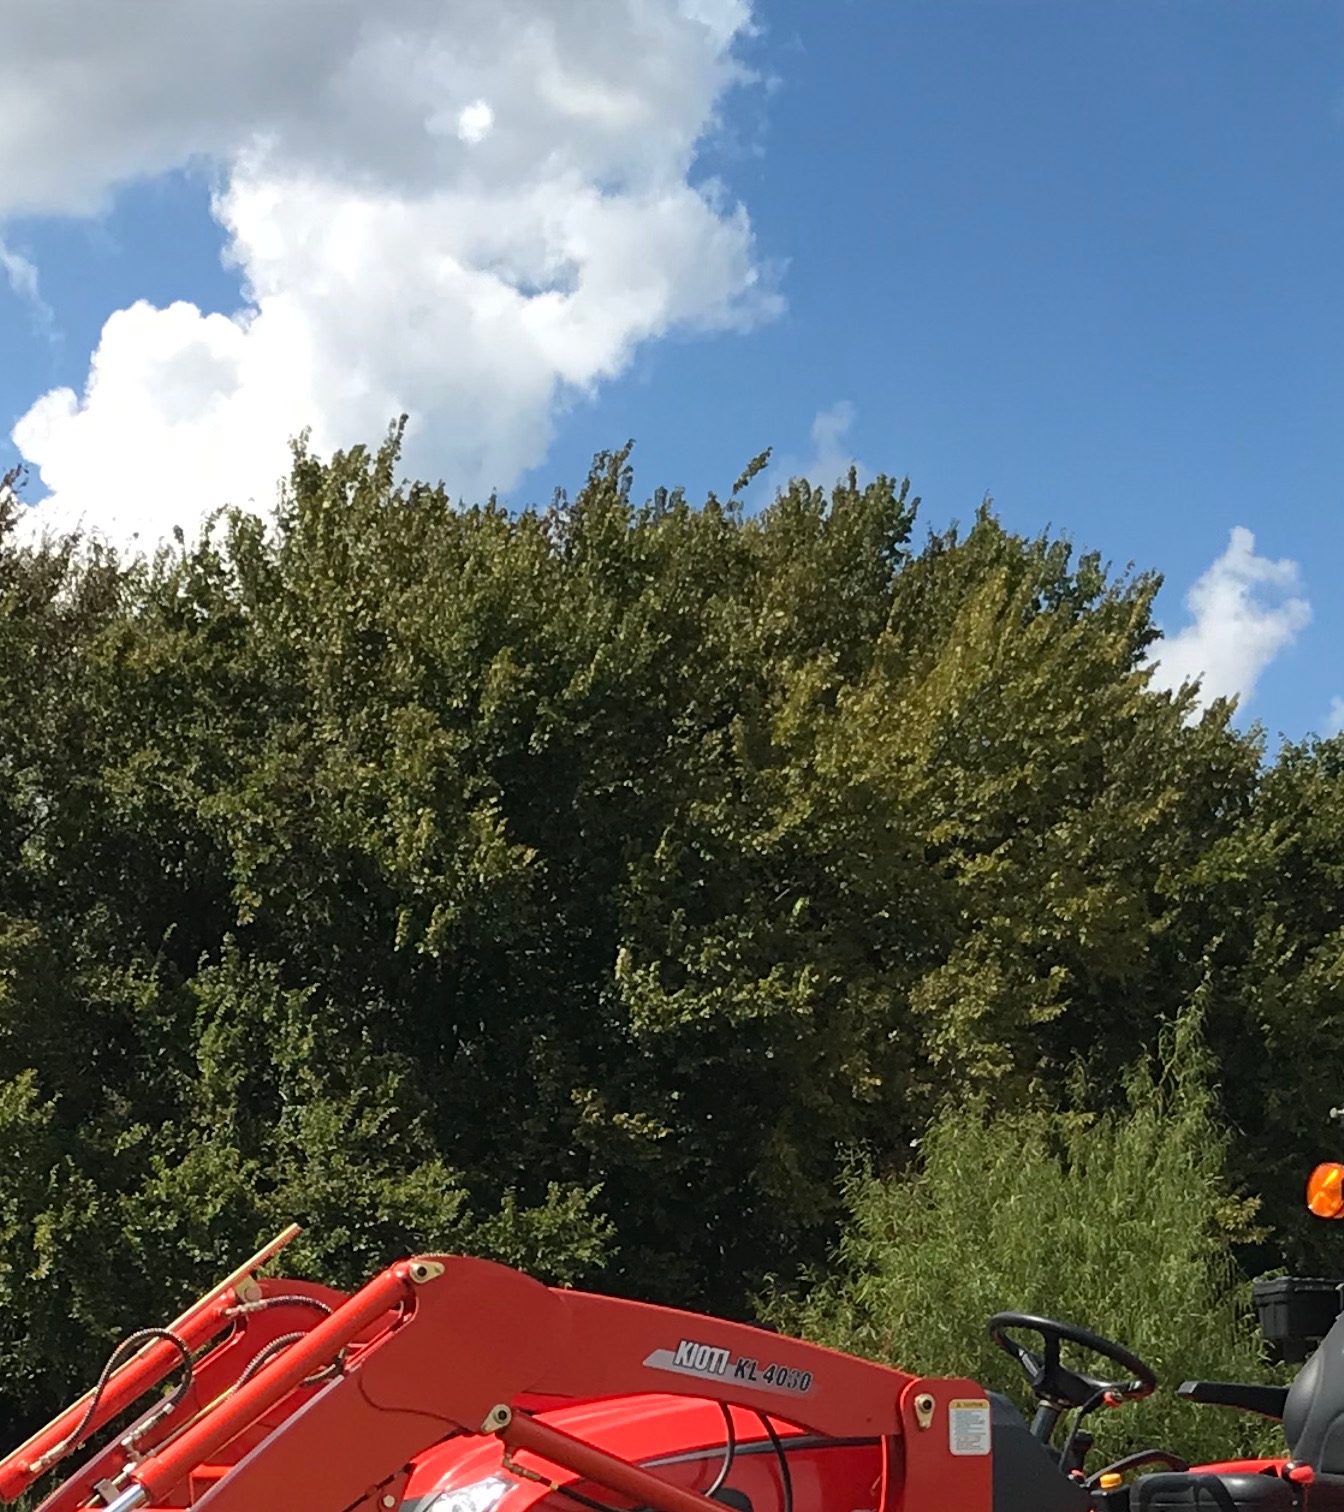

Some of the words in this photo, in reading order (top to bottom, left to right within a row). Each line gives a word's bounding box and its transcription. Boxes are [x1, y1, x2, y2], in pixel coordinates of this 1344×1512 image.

[674, 1340, 731, 1375] KIOTI
[733, 1358, 758, 1382] KL
[762, 1363, 812, 1392] 4030
